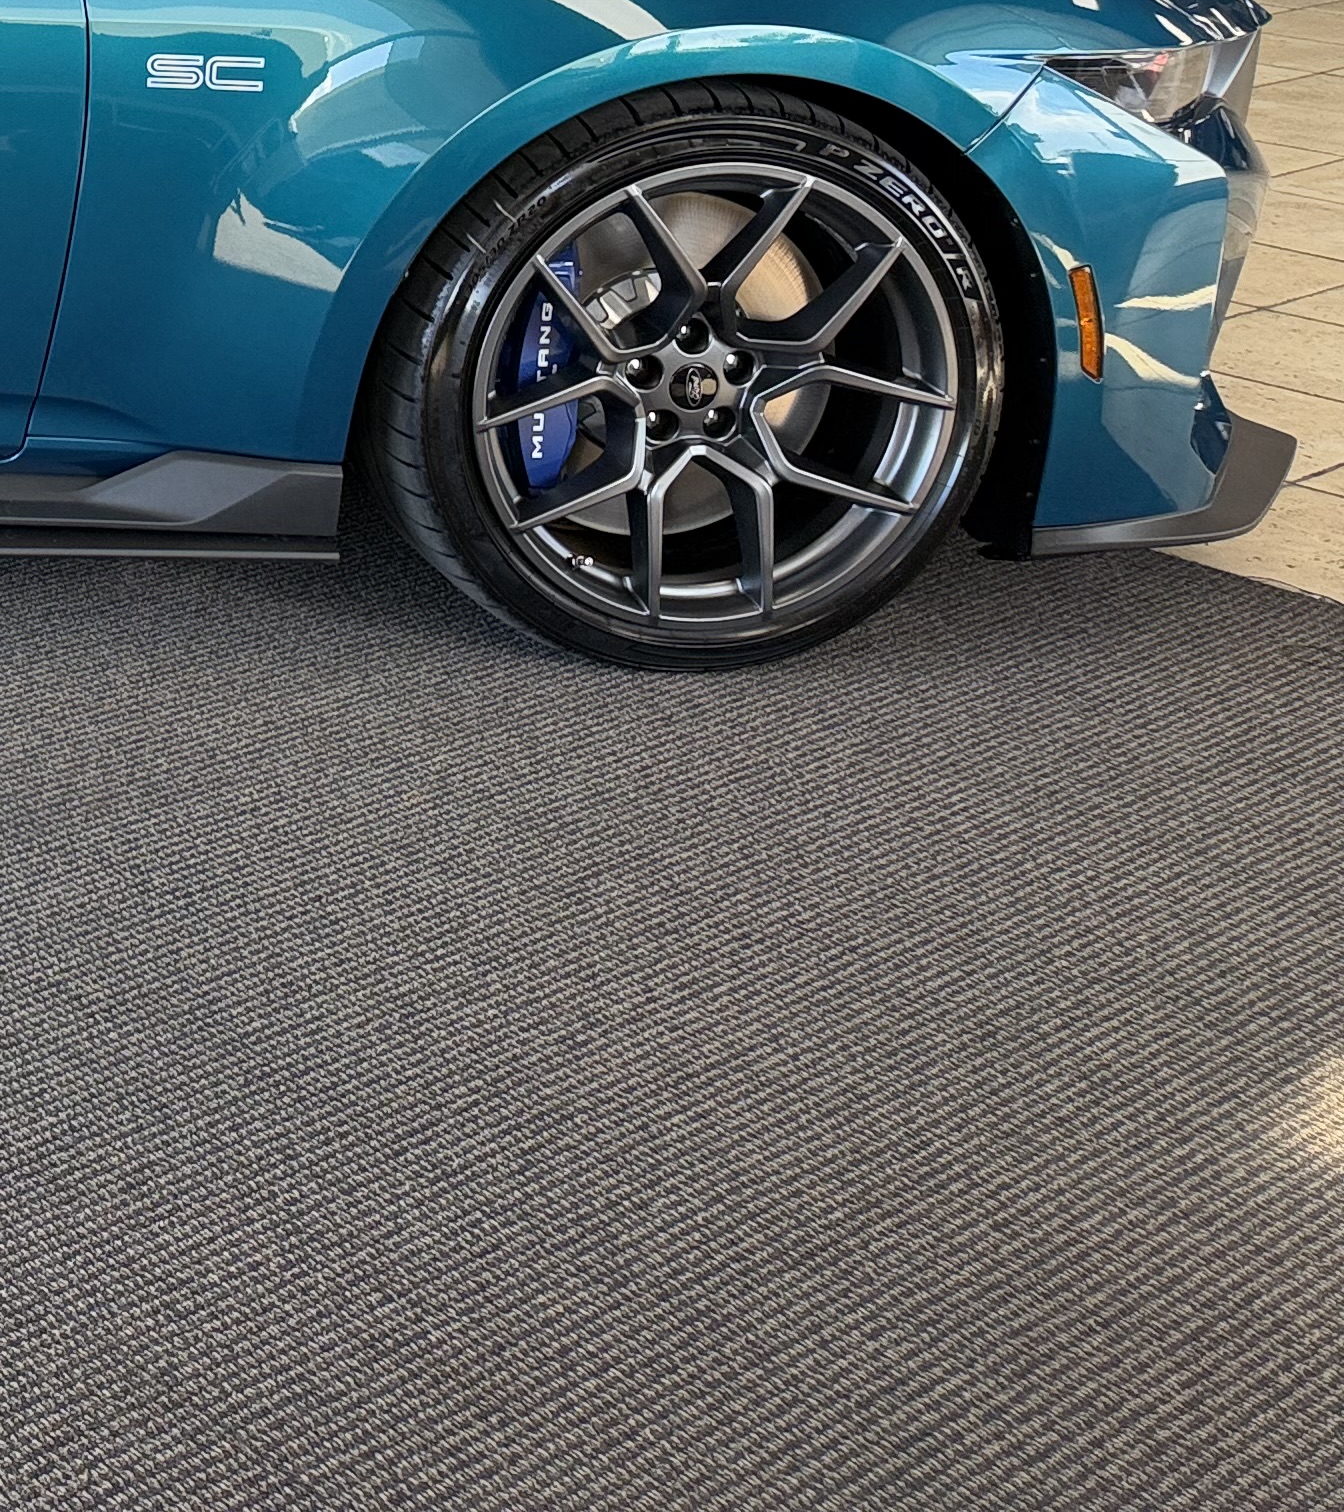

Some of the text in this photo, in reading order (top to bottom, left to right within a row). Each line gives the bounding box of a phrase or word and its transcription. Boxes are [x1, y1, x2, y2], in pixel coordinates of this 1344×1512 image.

[146, 53, 266, 93] SC
[818, 142, 850, 159] P
[853, 158, 950, 240] ZERO
[531, 302, 554, 460] MUTANG
